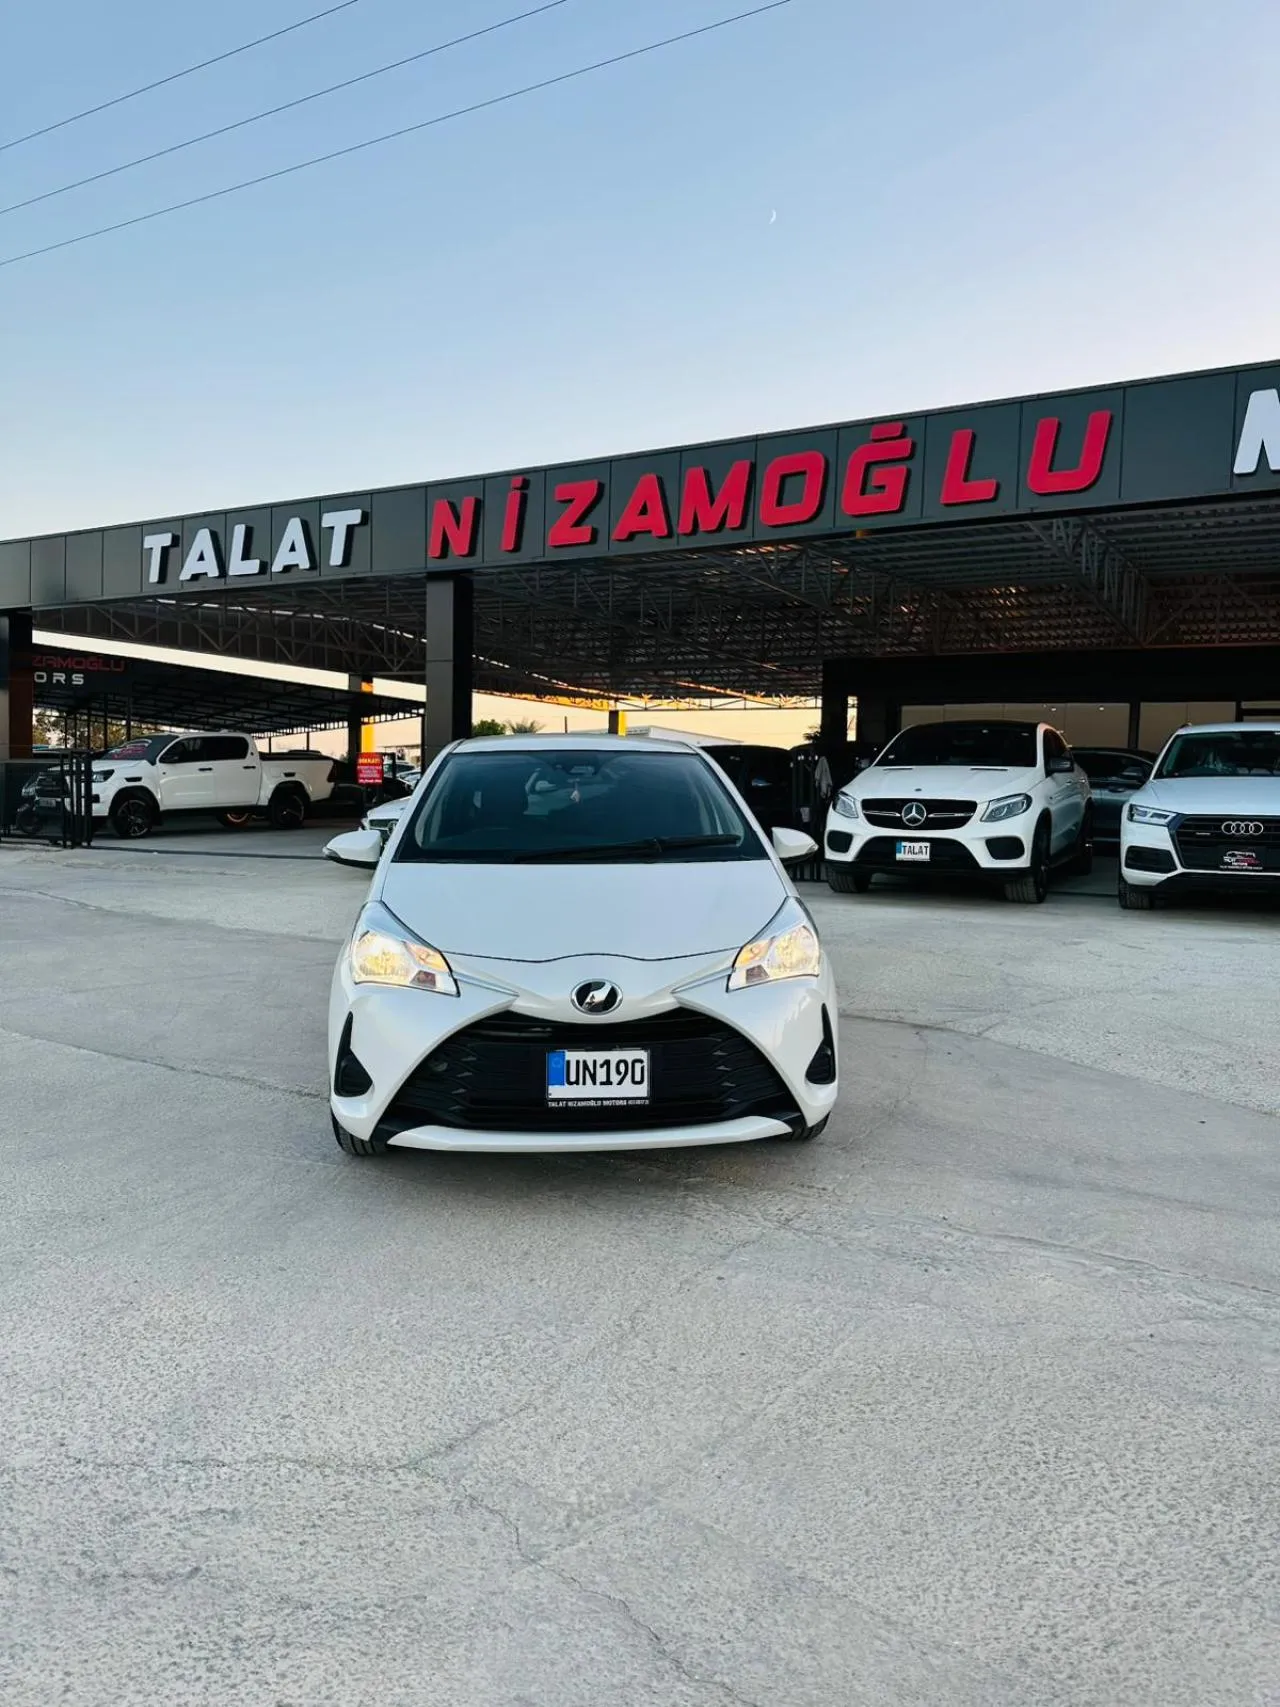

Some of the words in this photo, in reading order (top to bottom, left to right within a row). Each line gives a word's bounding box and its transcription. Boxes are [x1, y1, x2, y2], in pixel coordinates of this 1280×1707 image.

[144, 508, 363, 583] TALAT
[428, 411, 1110, 557] NİZAMOĞLU
[34, 671, 85, 685] ORS
[902, 845, 929, 856] TALAT
[565, 1058, 645, 1086] UN190
